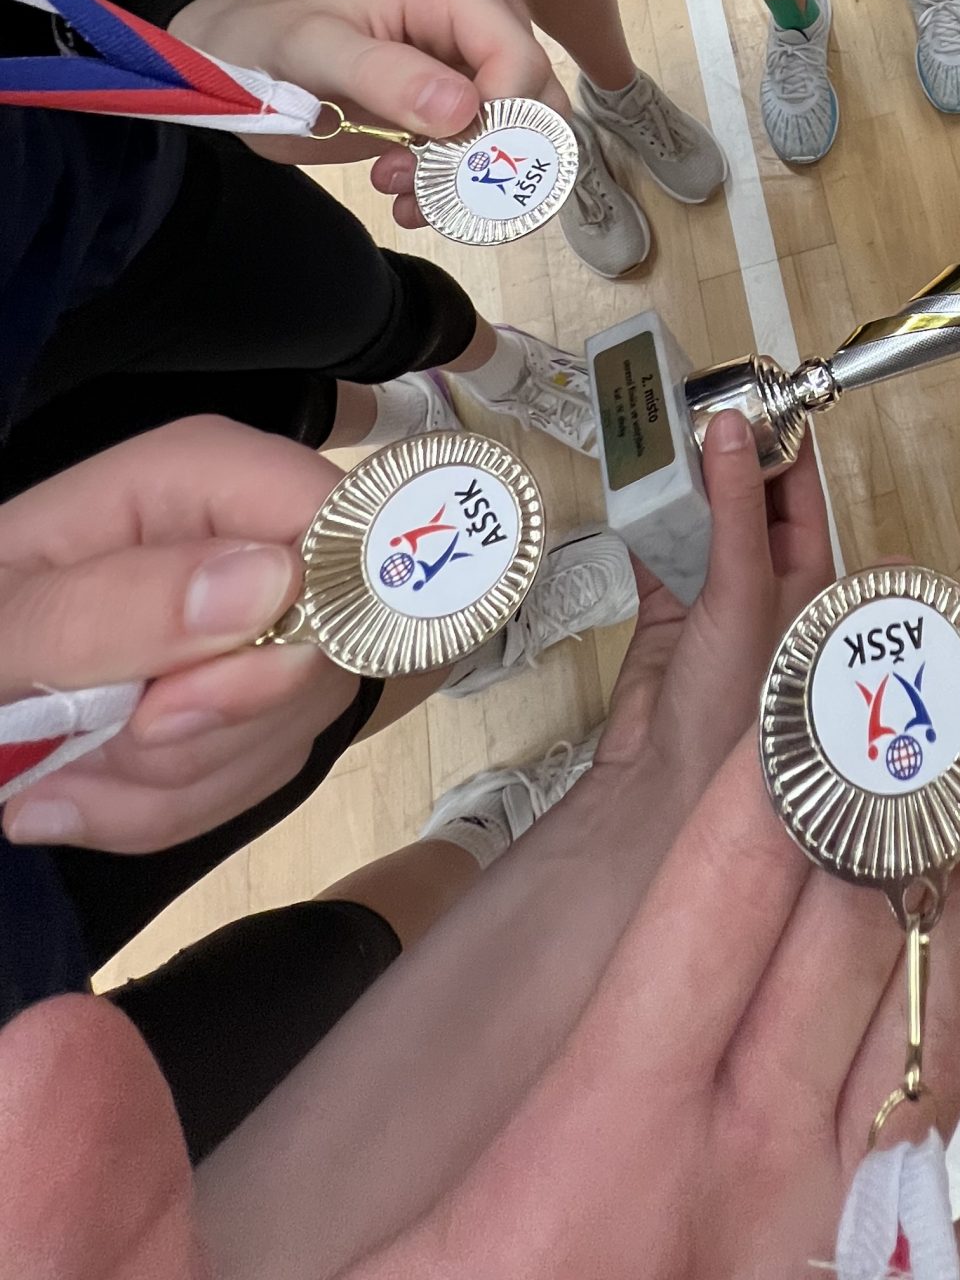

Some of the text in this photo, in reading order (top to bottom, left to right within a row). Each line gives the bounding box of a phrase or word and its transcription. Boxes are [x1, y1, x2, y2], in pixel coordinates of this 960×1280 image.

[513, 158, 551, 206] AŠSK
[644, 388, 659, 423] místo
[454, 479, 507, 547] AŠSK
[843, 616, 924, 668] AŠSK
